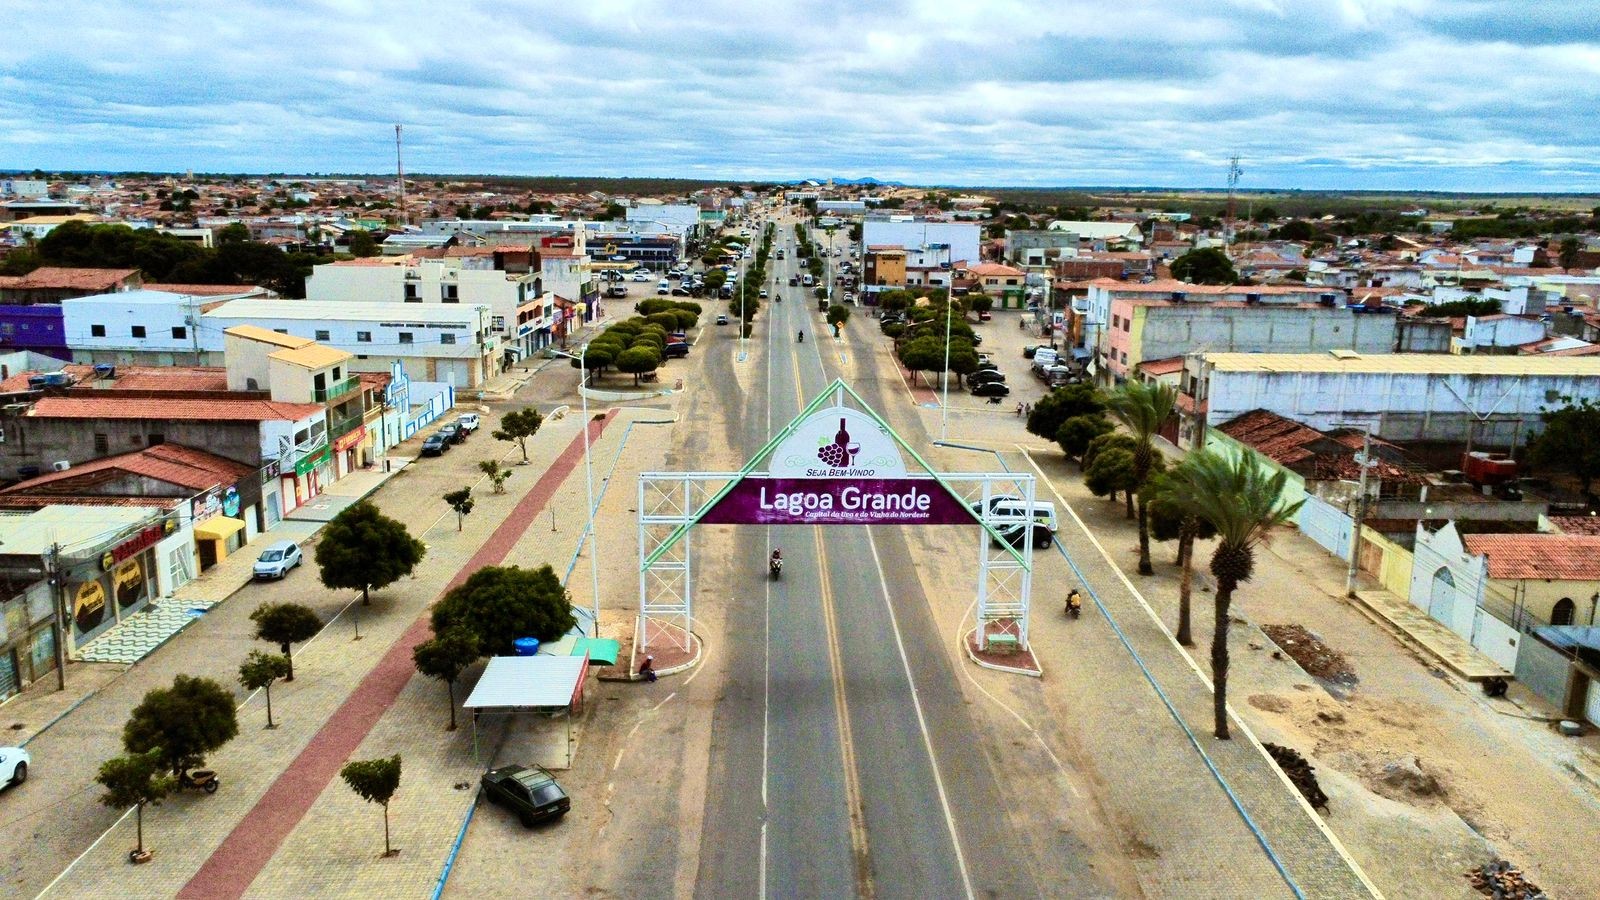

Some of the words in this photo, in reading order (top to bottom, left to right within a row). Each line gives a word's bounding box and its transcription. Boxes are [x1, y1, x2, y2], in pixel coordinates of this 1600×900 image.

[806, 468, 827, 477] SEJA
[828, 468, 875, 477] BEM-VINDO
[760, 486, 833, 516] Lagoa
[841, 486, 931, 511] Grande
[805, 511, 830, 519] Capital
